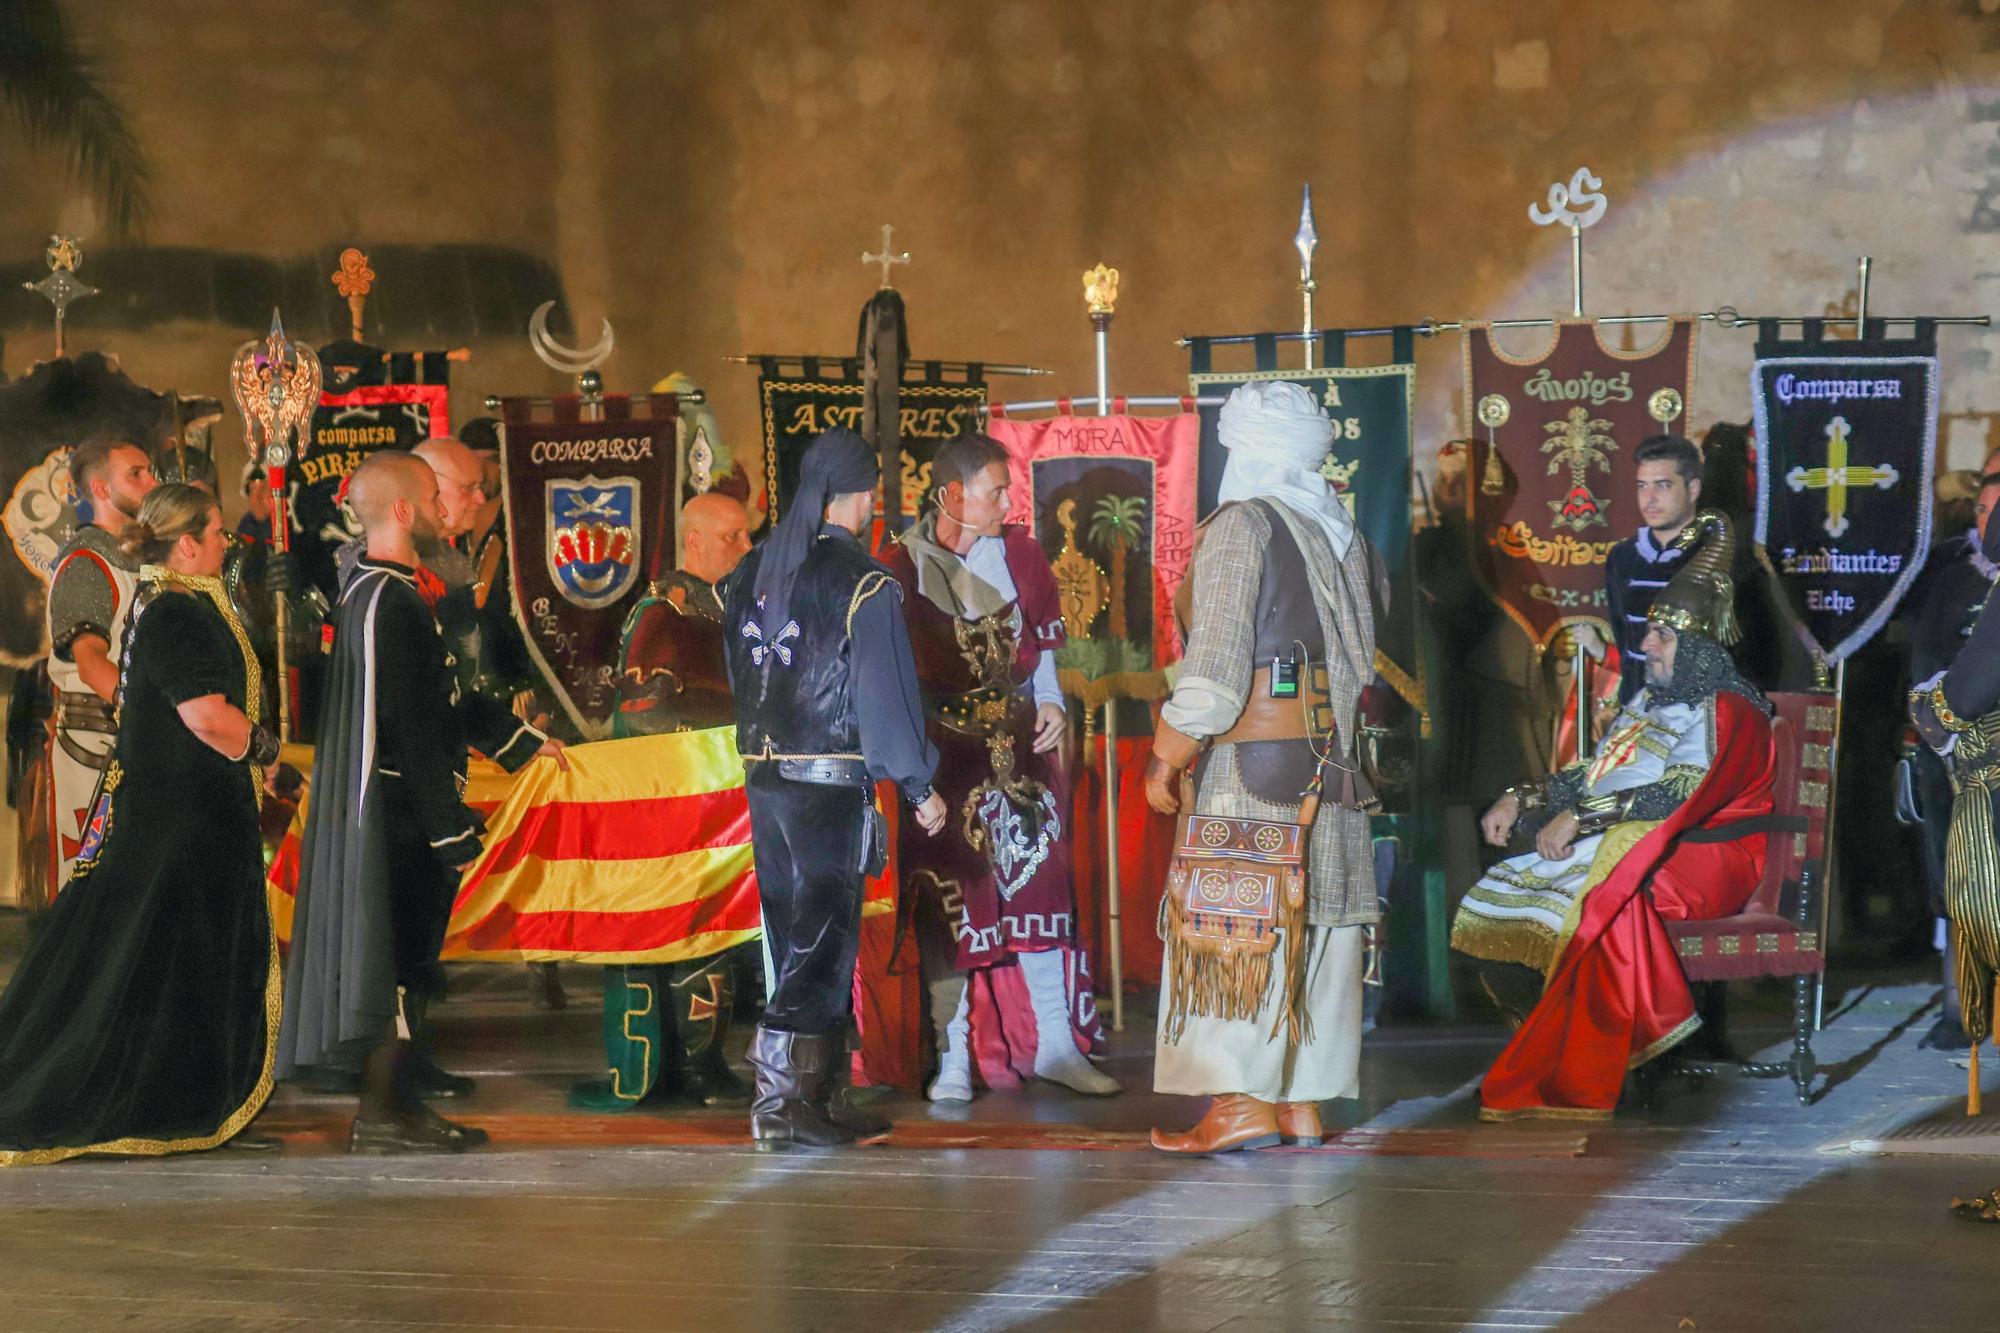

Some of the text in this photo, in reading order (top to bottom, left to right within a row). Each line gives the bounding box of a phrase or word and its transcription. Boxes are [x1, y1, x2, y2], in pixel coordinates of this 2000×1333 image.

[1776, 373, 1902, 404] Comparsa
[530, 436, 653, 464] COMPARSA
[1053, 427, 1127, 451] MORA
[301, 451, 372, 485] PIRA
[1806, 590, 1856, 616] Elche
